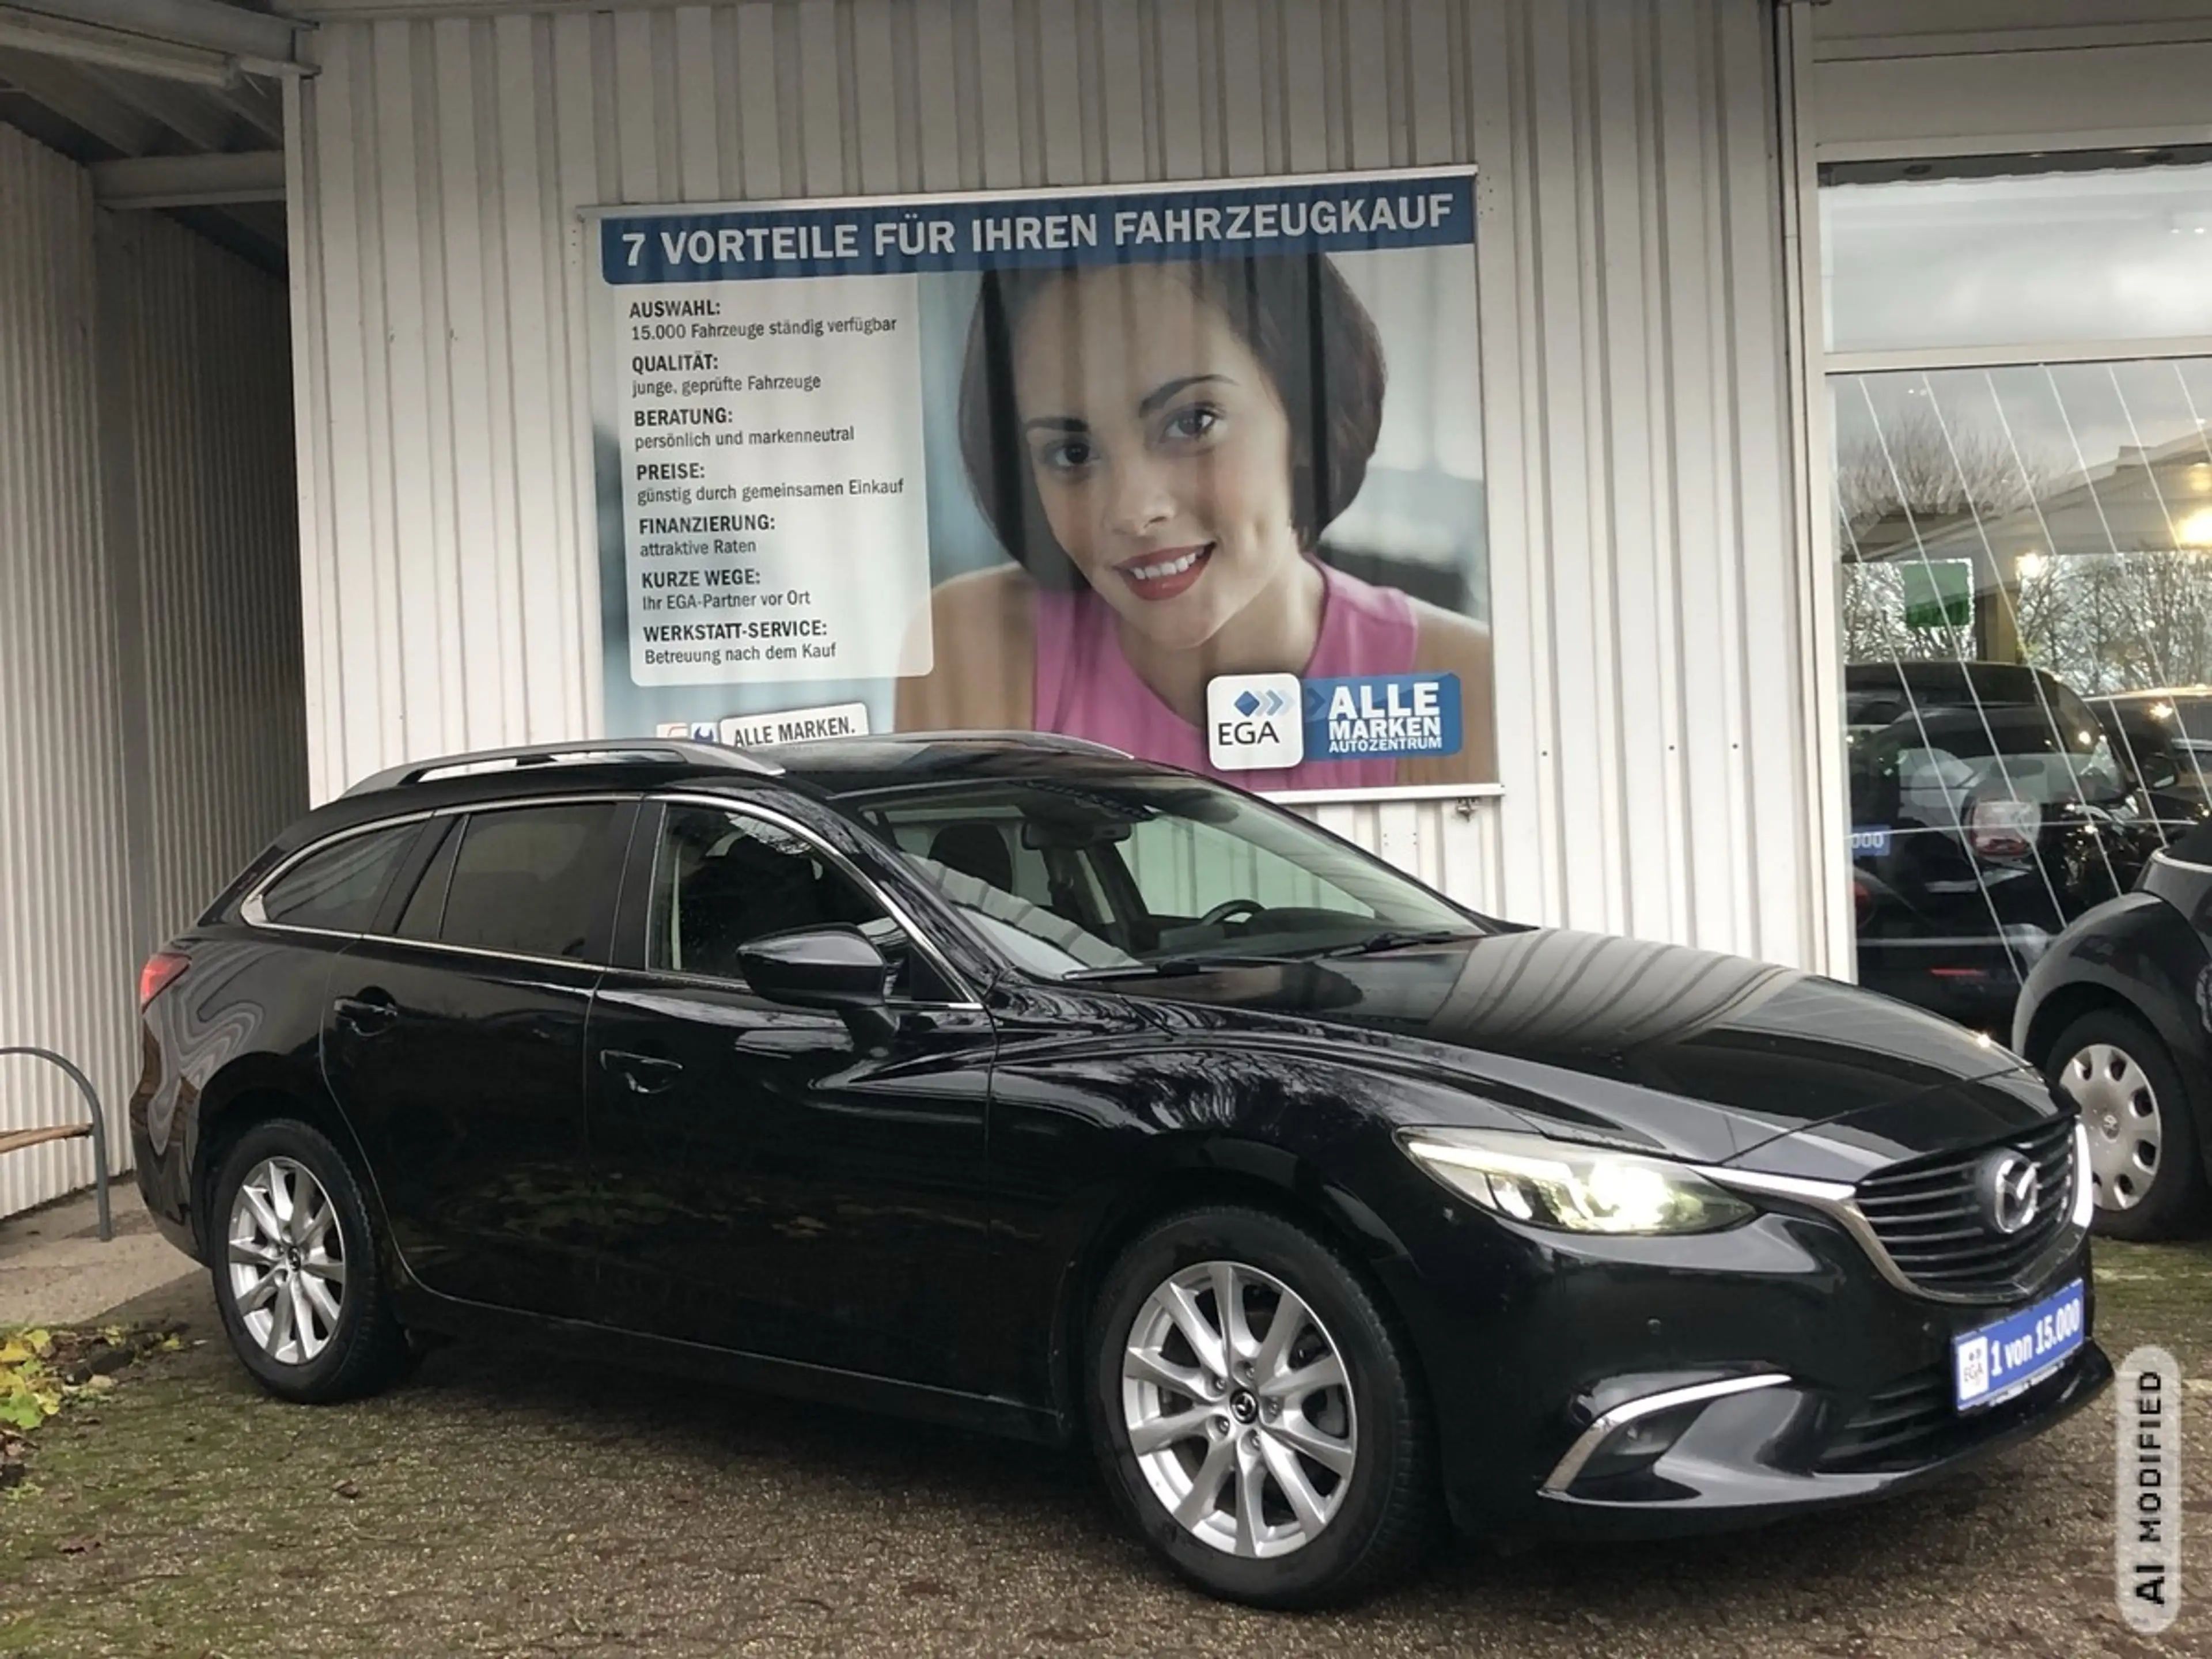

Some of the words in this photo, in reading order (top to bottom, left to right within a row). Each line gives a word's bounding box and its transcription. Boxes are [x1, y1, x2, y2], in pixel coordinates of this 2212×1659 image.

[622, 233, 646, 266] 7
[660, 224, 859, 266] VORTEILE
[874, 213, 956, 256] FÜR
[971, 213, 1097, 253] IHREN
[1114, 194, 1455, 245] FAHRZEUGKAUF
[629, 300, 721, 319] AUSWAHL:
[631, 324, 686, 340] 15.000
[691, 320, 764, 340] Fahrzeuge
[768, 319, 824, 337] ständig
[827, 316, 897, 335] verfügbar
[632, 351, 718, 375] QUALITÄT:
[681, 375, 743, 397] geprüfte
[748, 374, 821, 392] Fahrzeuge
[634, 407, 733, 427] BERATUNG:
[635, 432, 711, 452] persönlich
[715, 430, 743, 446] und
[748, 426, 854, 445] markenneutral
[637, 463, 705, 480] PREISE:
[637, 486, 692, 506] günstig
[696, 484, 737, 502] durch
[742, 482, 844, 502] gemeinsamen
[849, 478, 904, 494] Einkauf
[639, 514, 775, 535] FINANZIERUNG:
[640, 541, 709, 557] attraktive
[714, 539, 757, 555] Raten
[642, 571, 700, 589] KURZE
[704, 569, 761, 586] WEGE:
[643, 595, 663, 611] Ihr
[666, 593, 756, 609] EGA-Partner
[760, 592, 783, 606] vor
[787, 590, 811, 606] Ort
[643, 619, 828, 642] WERKSTATT-SERVICE:
[645, 647, 722, 665] Betreuung
[725, 646, 760, 661] nach
[765, 645, 797, 660] dem
[802, 642, 838, 658] Kauf
[1328, 682, 1440, 720] ALLE
[734, 725, 774, 748] ALLE
[778, 715, 856, 742] MARKEN.
[1218, 721, 1280, 746] EGA
[1328, 716, 1441, 741] MARKEN
[1328, 736, 1442, 753] AUTOZENTRUM
[1991, 1340, 2002, 1376] 1
[2004, 1334, 2033, 1369] von
[2035, 1298, 2081, 1355] 15.000
